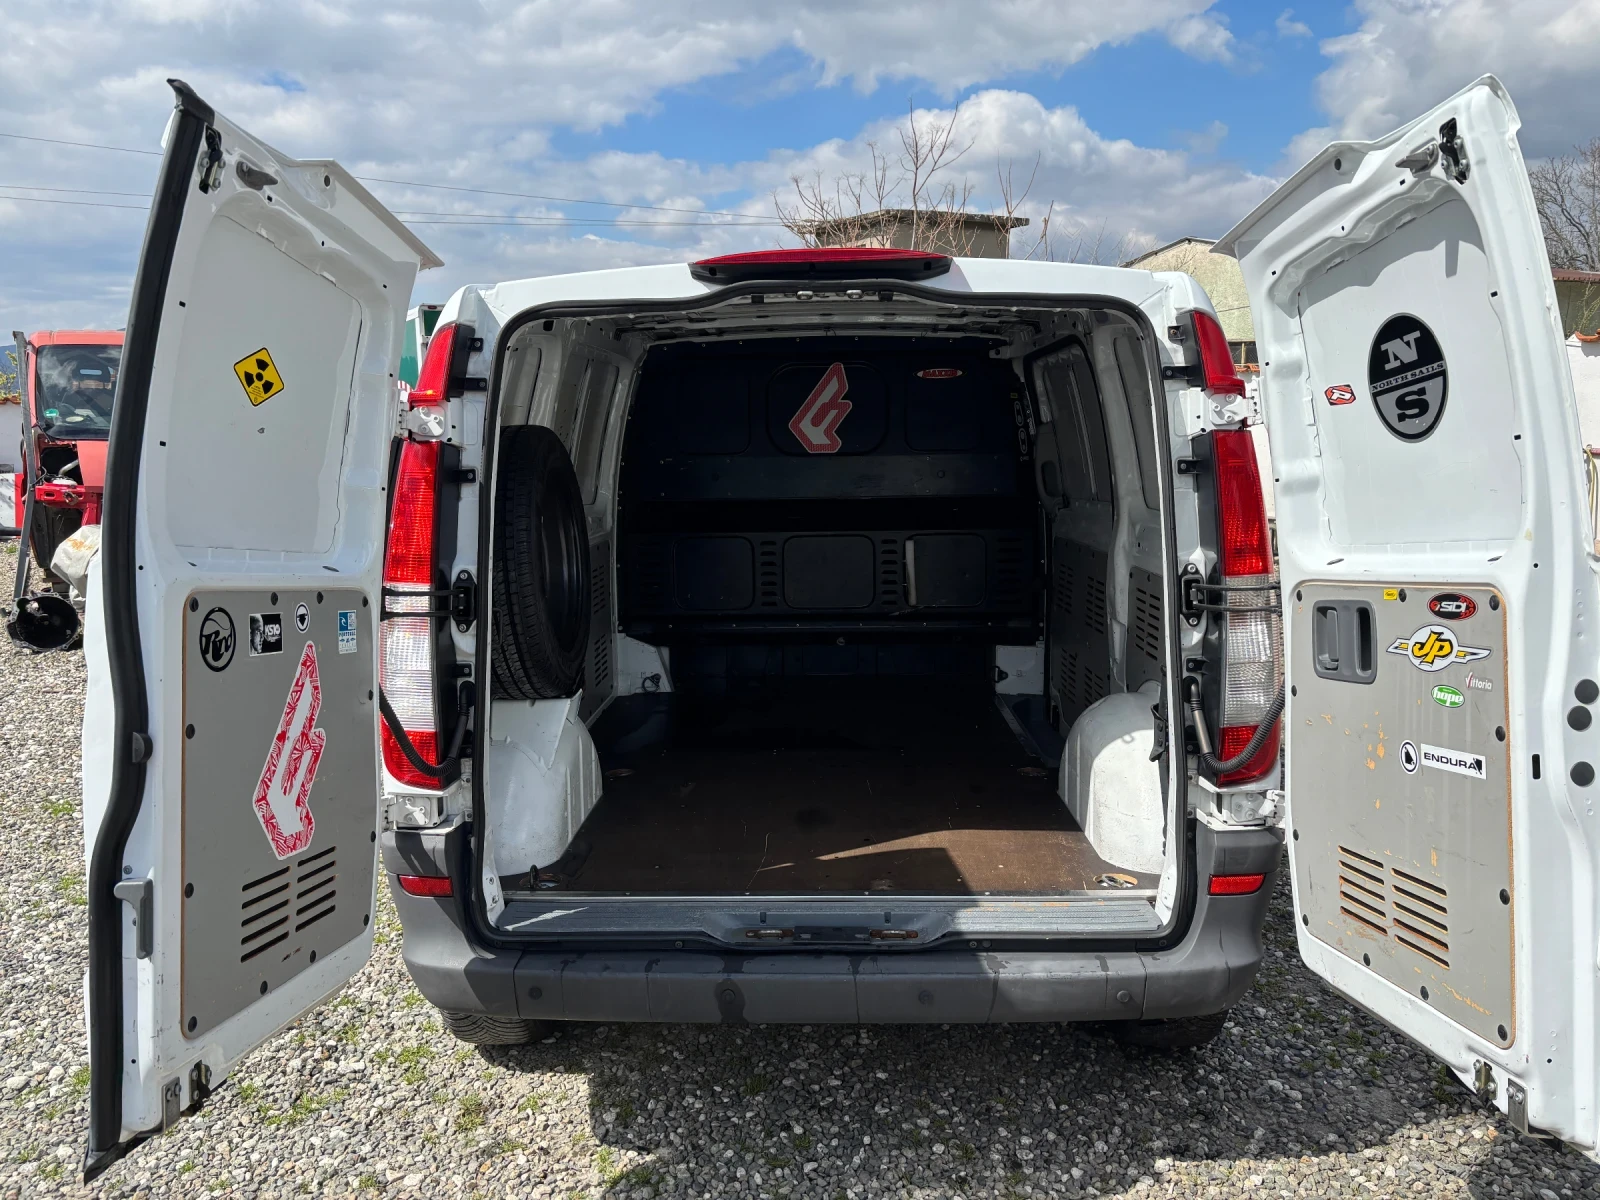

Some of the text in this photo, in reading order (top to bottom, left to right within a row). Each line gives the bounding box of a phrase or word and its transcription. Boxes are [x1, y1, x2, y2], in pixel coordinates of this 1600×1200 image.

[1380, 330, 1421, 371] N
[1371, 362, 1444, 391] NORTH SAILS
[1395, 386, 1430, 423] S
[1465, 671, 1493, 690] Vittoria
[1432, 686, 1464, 707] hope
[1423, 751, 1479, 772] ENDURA
